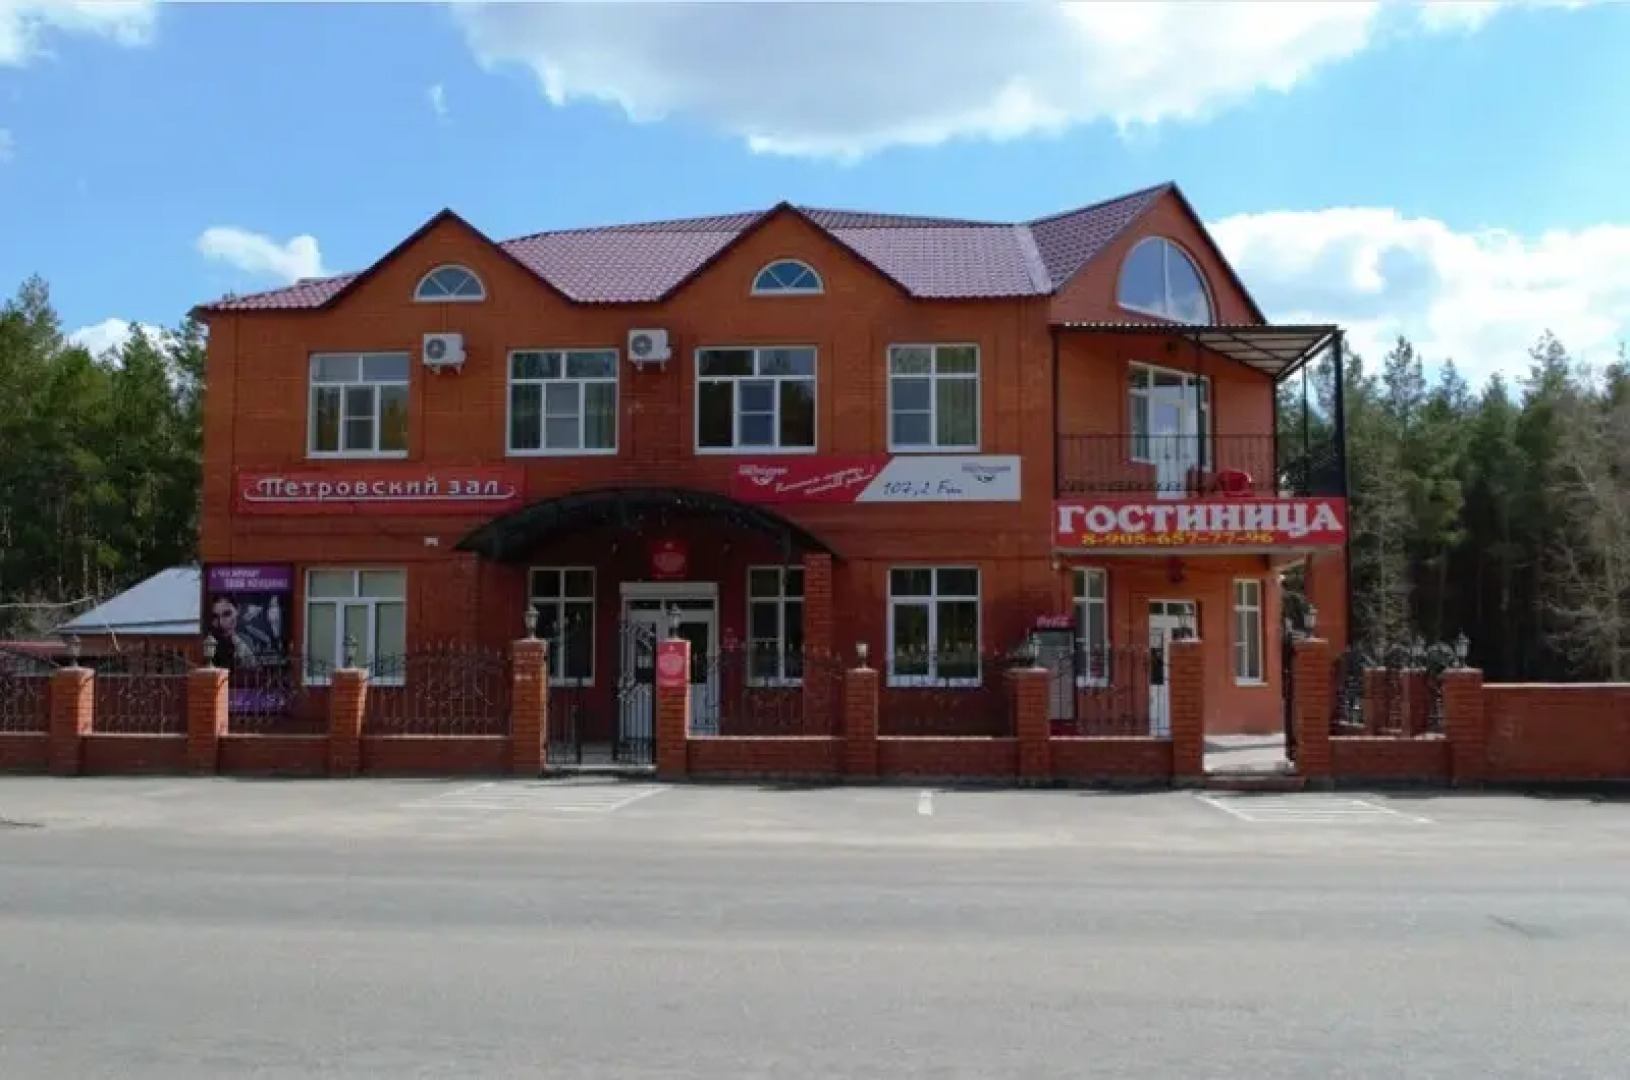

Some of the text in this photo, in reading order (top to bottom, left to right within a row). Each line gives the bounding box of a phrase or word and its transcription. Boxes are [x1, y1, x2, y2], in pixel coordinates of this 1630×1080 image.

[257, 475, 498, 501] Петровский зал
[1058, 503, 1342, 537] ГОСТИНИЦА
